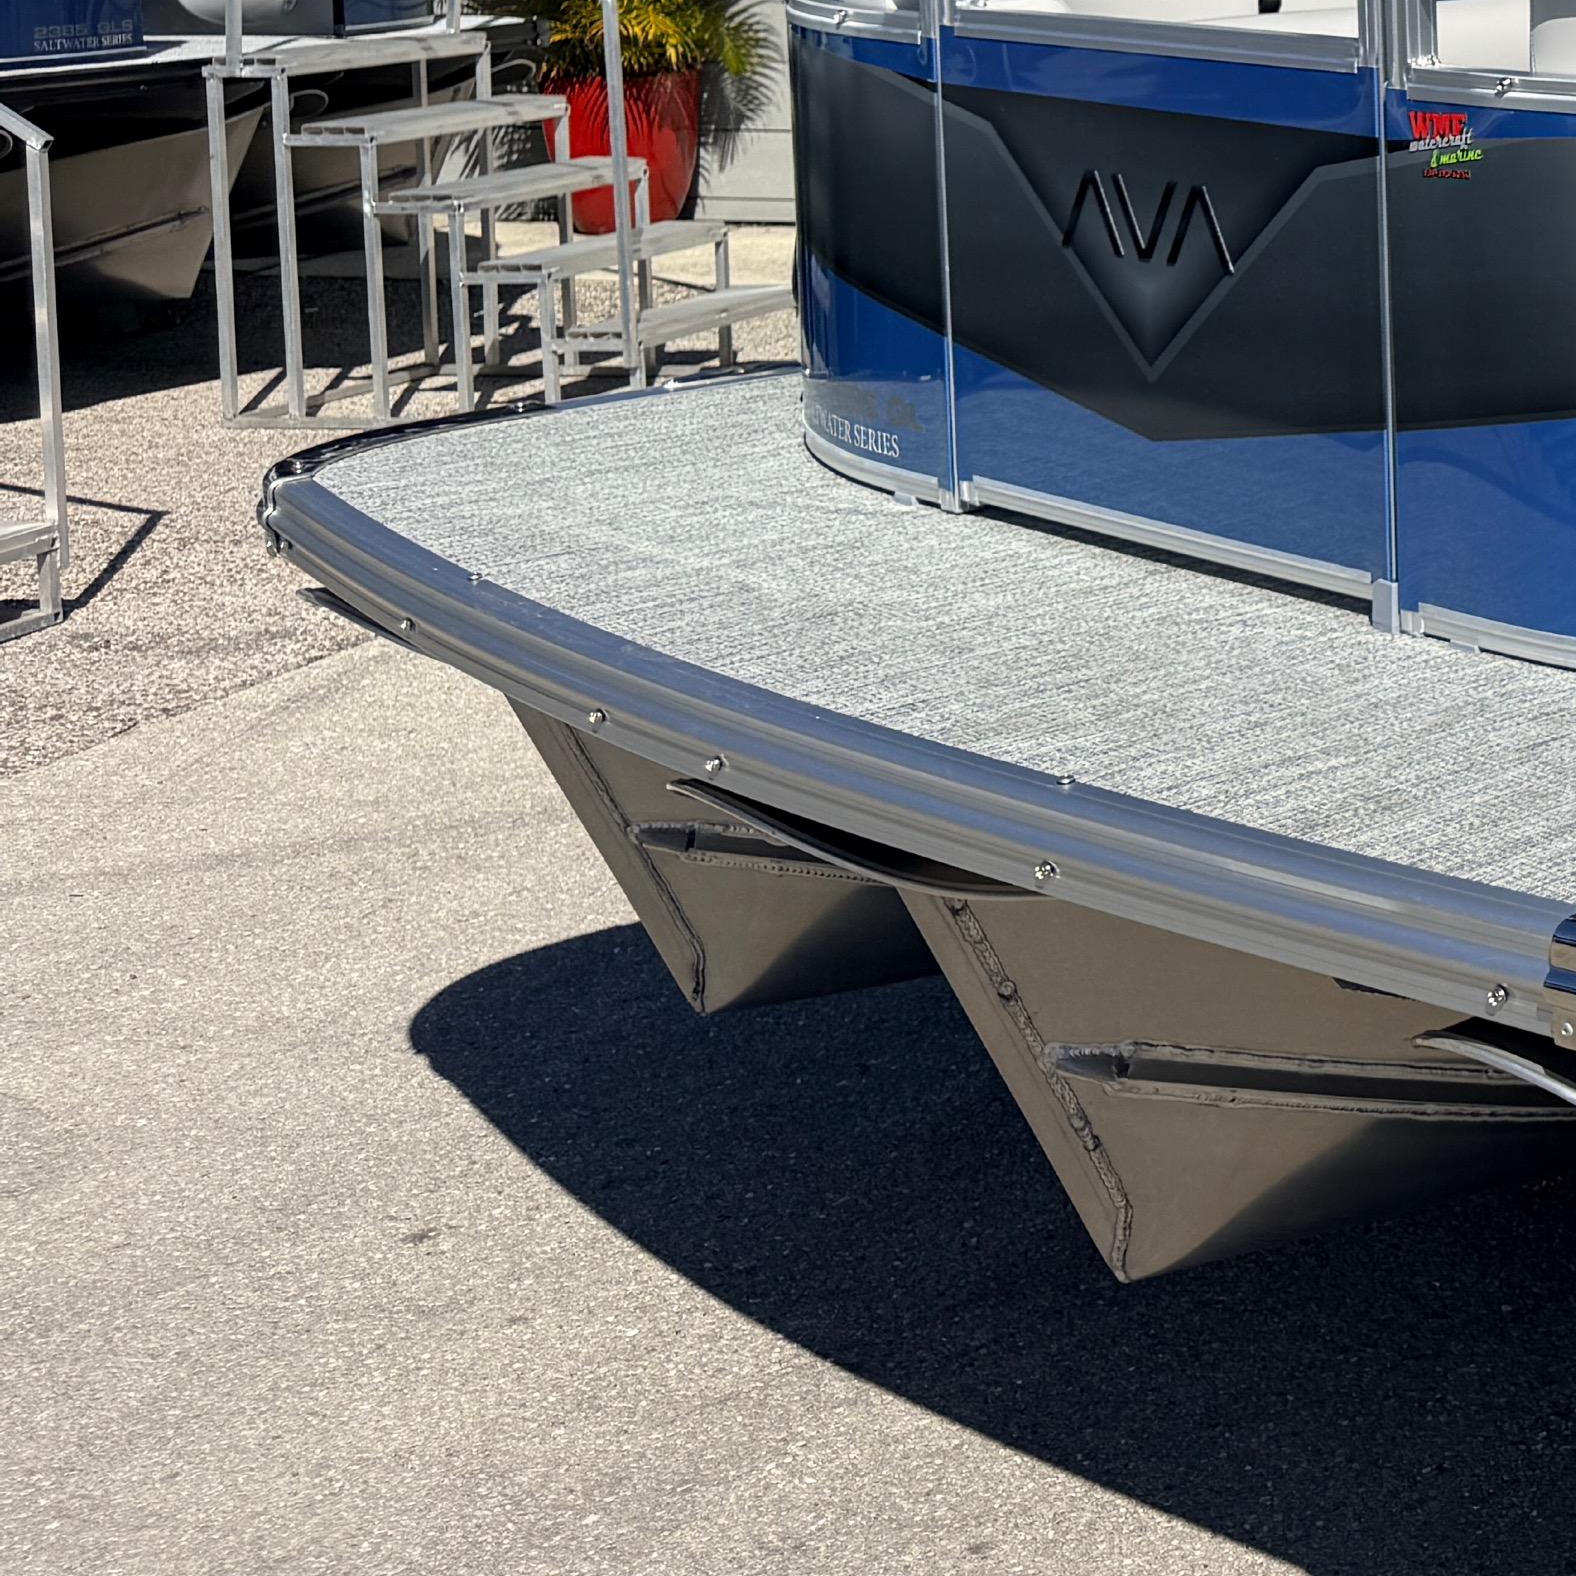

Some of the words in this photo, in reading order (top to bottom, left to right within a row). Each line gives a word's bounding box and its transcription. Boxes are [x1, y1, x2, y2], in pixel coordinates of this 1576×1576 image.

[33, 37, 99, 51] SALTWATER
[101, 33, 133, 48] SERIES
[1409, 111, 1467, 140] WMF
[1409, 128, 1473, 152] watercraft
[1440, 148, 1483, 165] marine
[1062, 170, 1234, 276] AVA
[853, 424, 900, 458] SERIES
